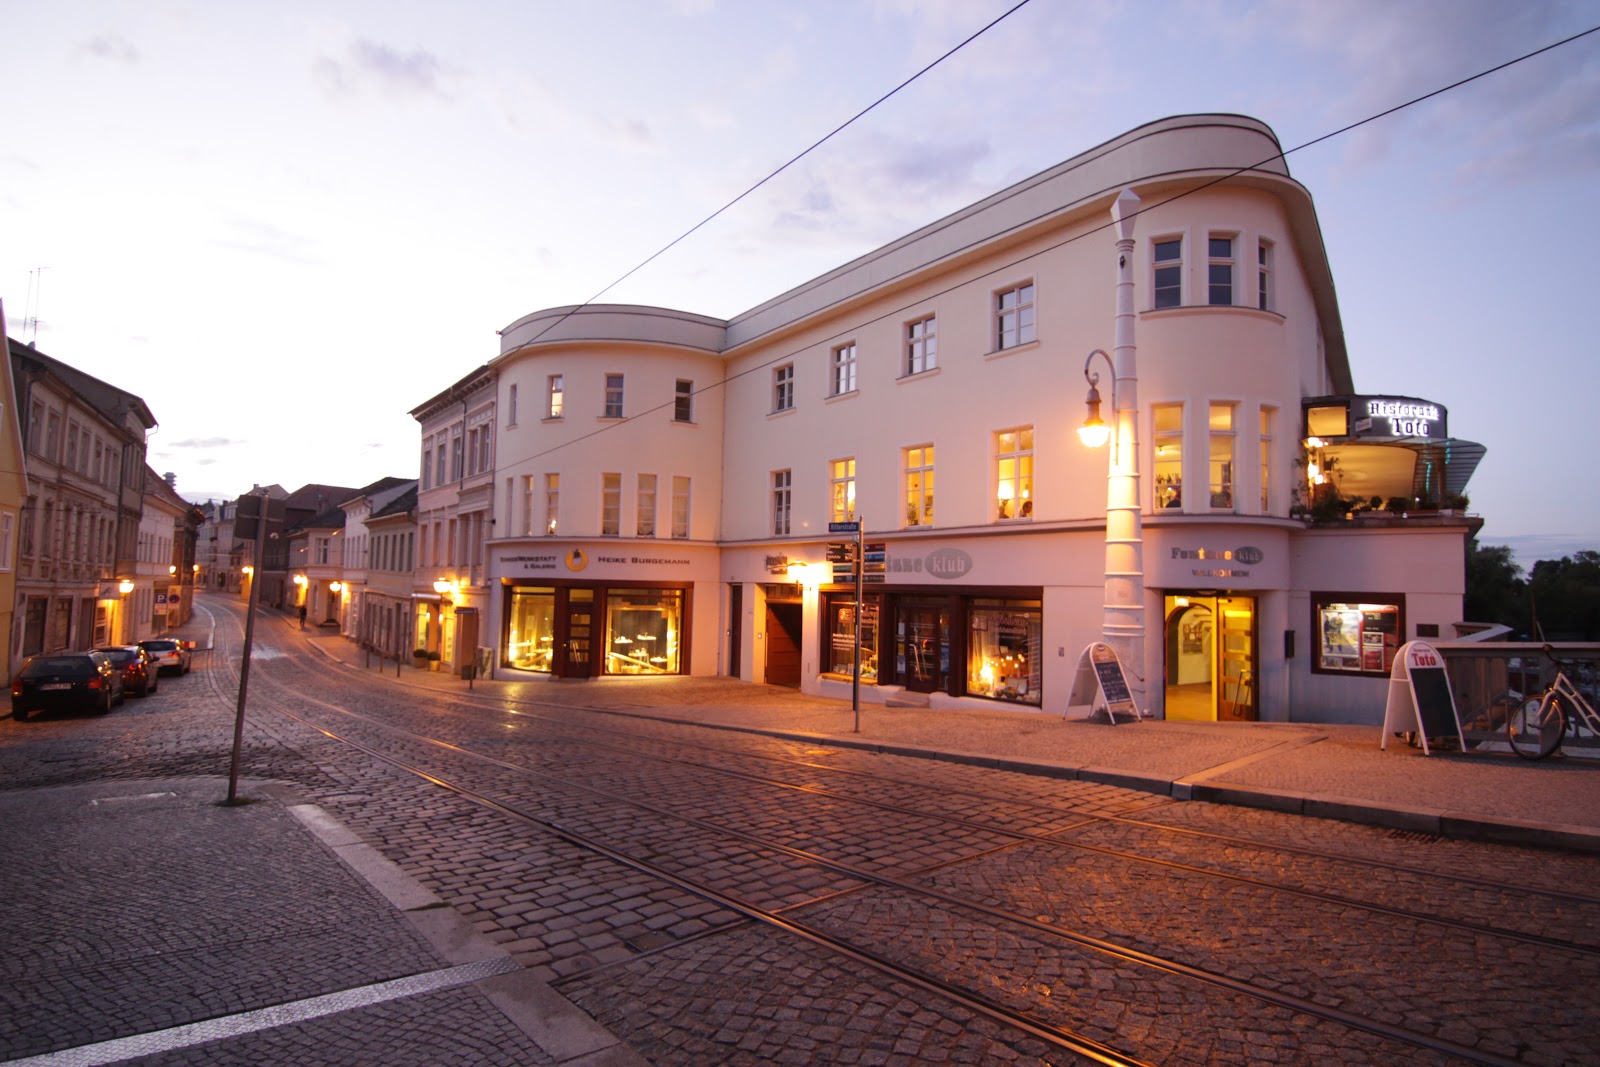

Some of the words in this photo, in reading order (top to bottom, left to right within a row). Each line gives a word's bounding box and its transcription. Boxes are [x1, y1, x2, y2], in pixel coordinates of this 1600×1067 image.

[830, 523, 857, 531] Ritterstraße
[1171, 547, 1232, 560] Fontane
[1239, 551, 1260, 561] klub
[631, 557, 690, 565] BURGEMANN
[933, 556, 965, 572] klub
[157, 594, 165, 603] P
